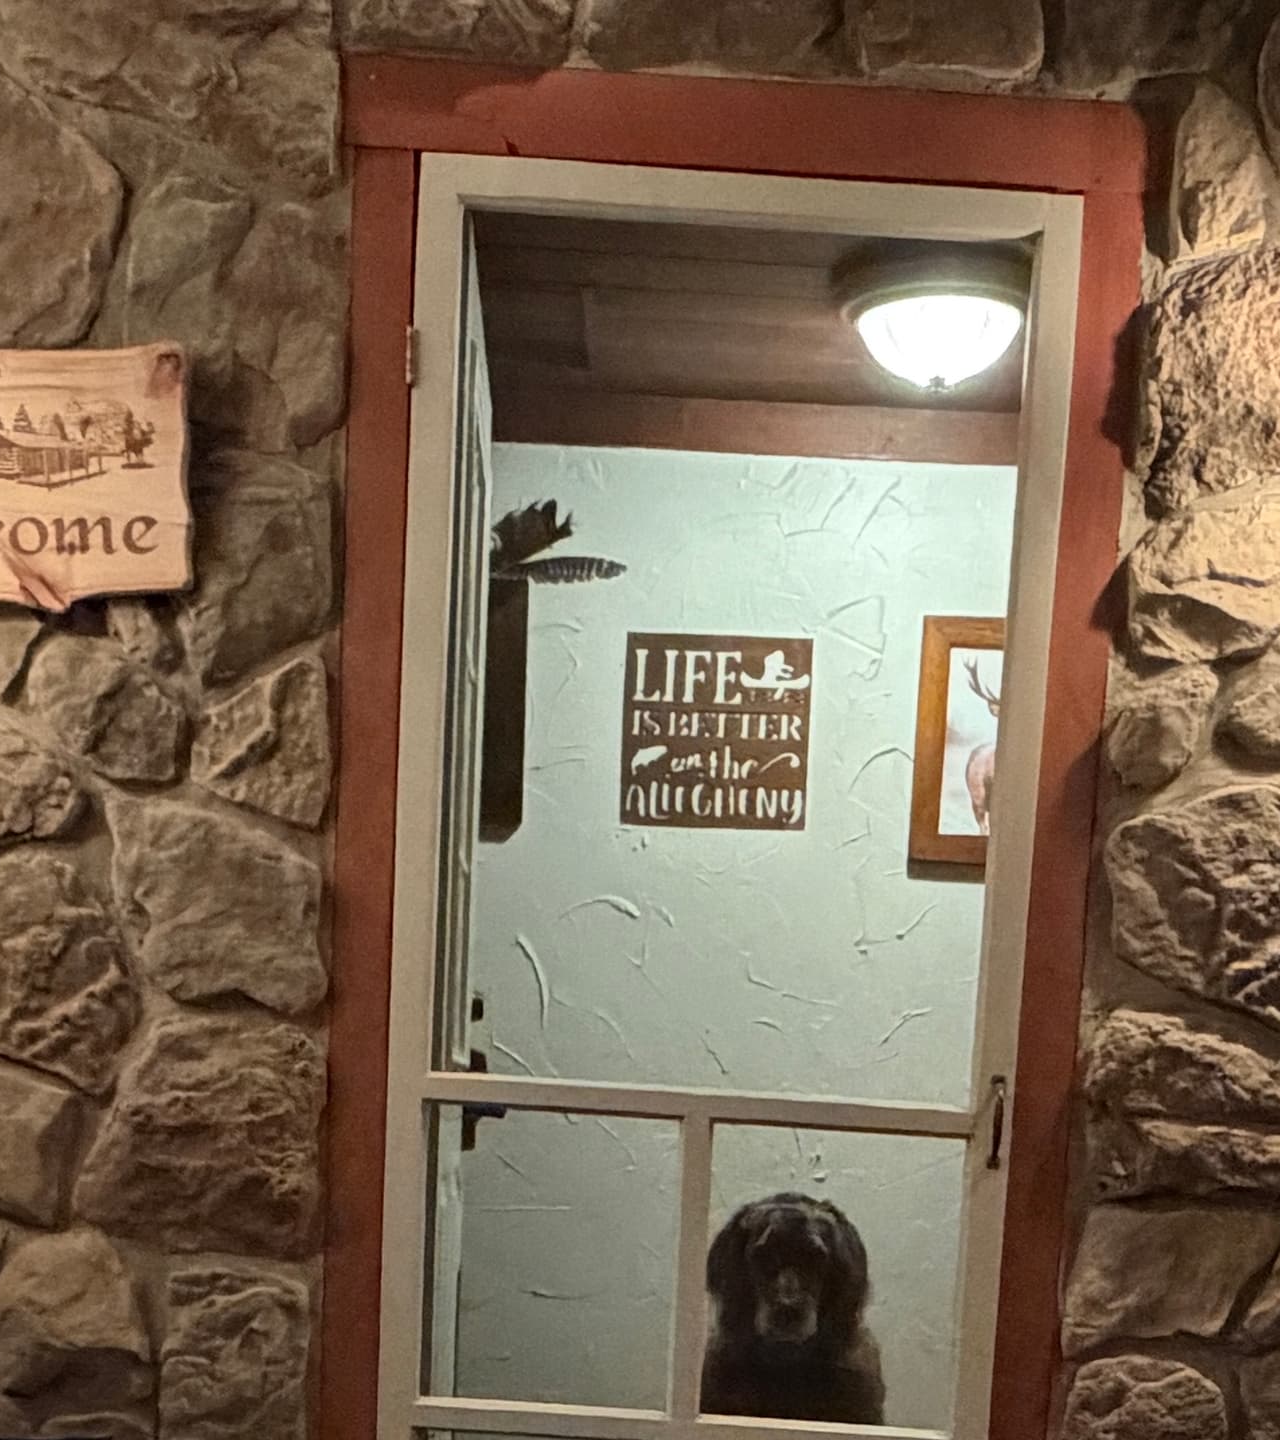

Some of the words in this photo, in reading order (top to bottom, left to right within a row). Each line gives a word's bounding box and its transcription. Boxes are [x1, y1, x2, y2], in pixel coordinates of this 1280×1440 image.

[631, 648, 742, 705] LIFE
[631, 709, 662, 736] IS
[667, 711, 802, 741] BETTER
[708, 745, 760, 780] the
